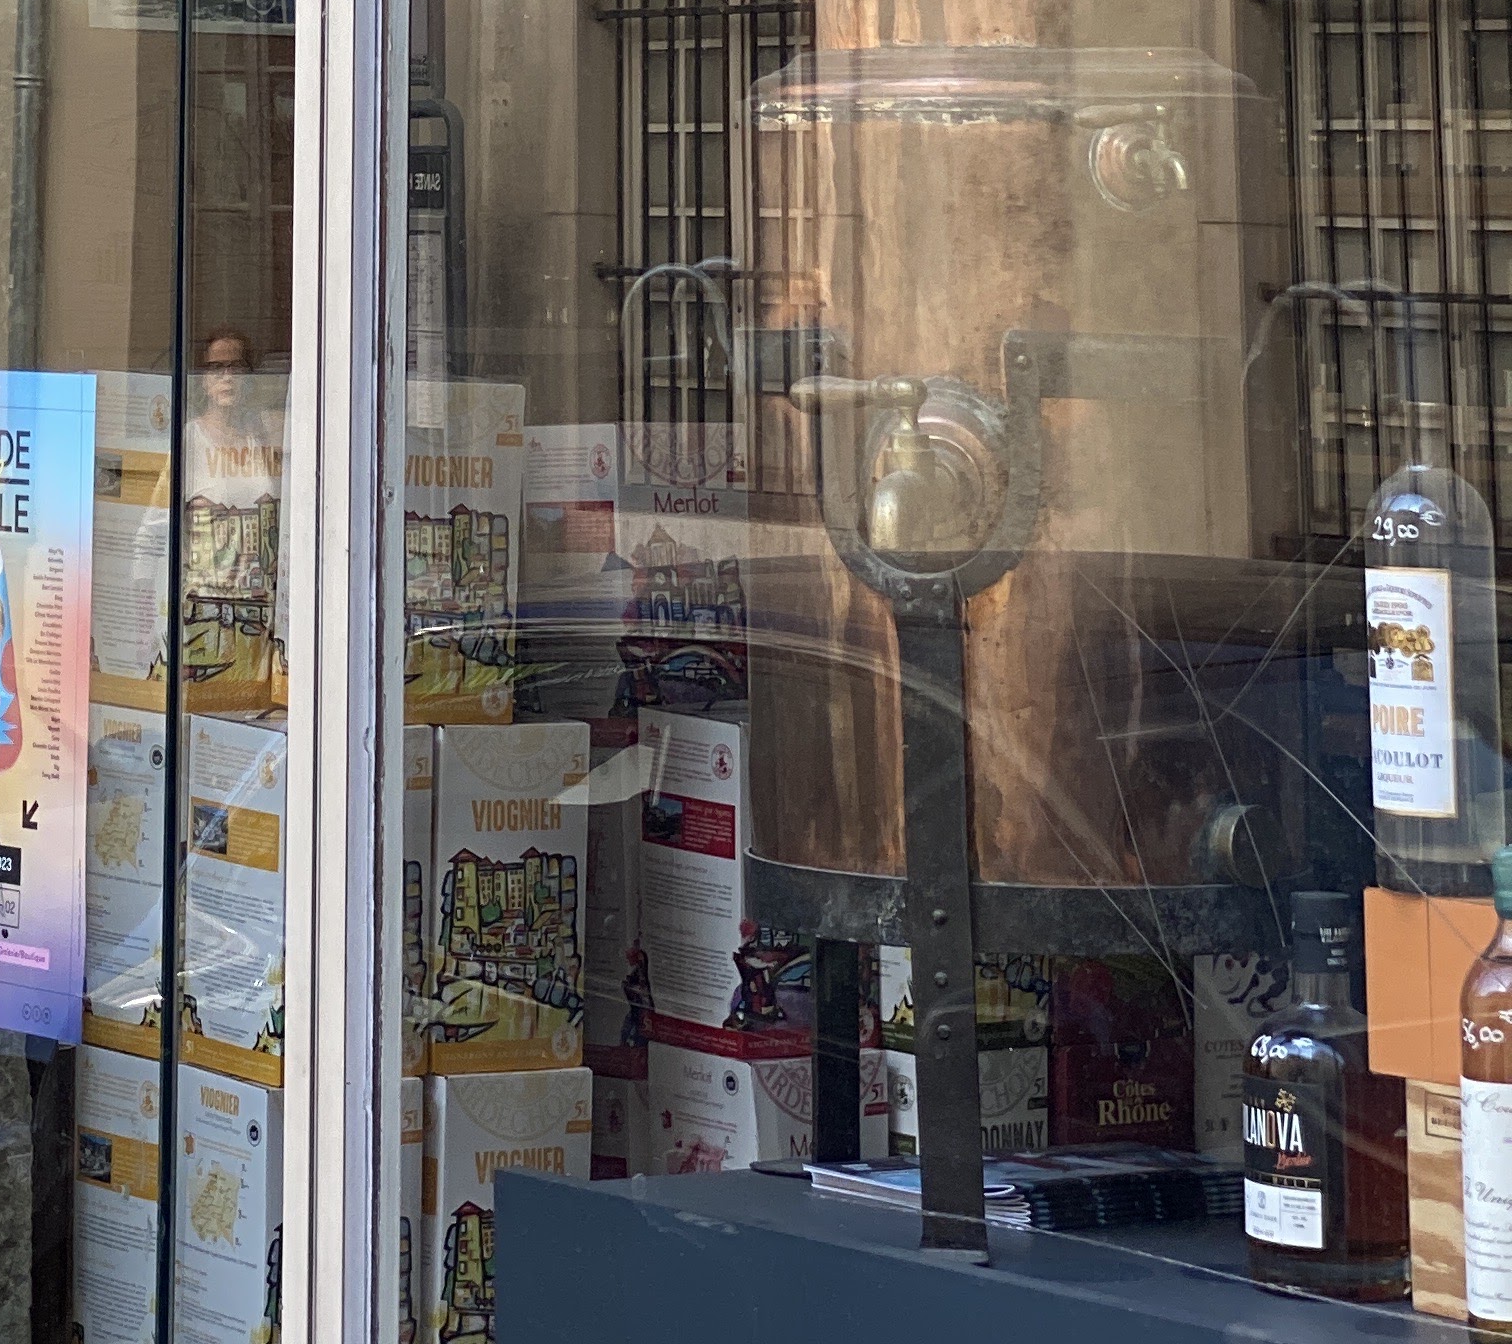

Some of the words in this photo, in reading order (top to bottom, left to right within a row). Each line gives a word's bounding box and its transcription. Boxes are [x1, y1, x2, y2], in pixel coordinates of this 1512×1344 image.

[653, 484, 719, 513] Merlot
[1372, 515, 1419, 547] 29,00
[471, 798, 562, 833] VIOGNIER
[5, 900, 16, 915] 02
[200, 1085, 240, 1117] VIOGNIER
[1112, 1078, 1156, 1098] Côtes
[1098, 1096, 1172, 1126] Rhône
